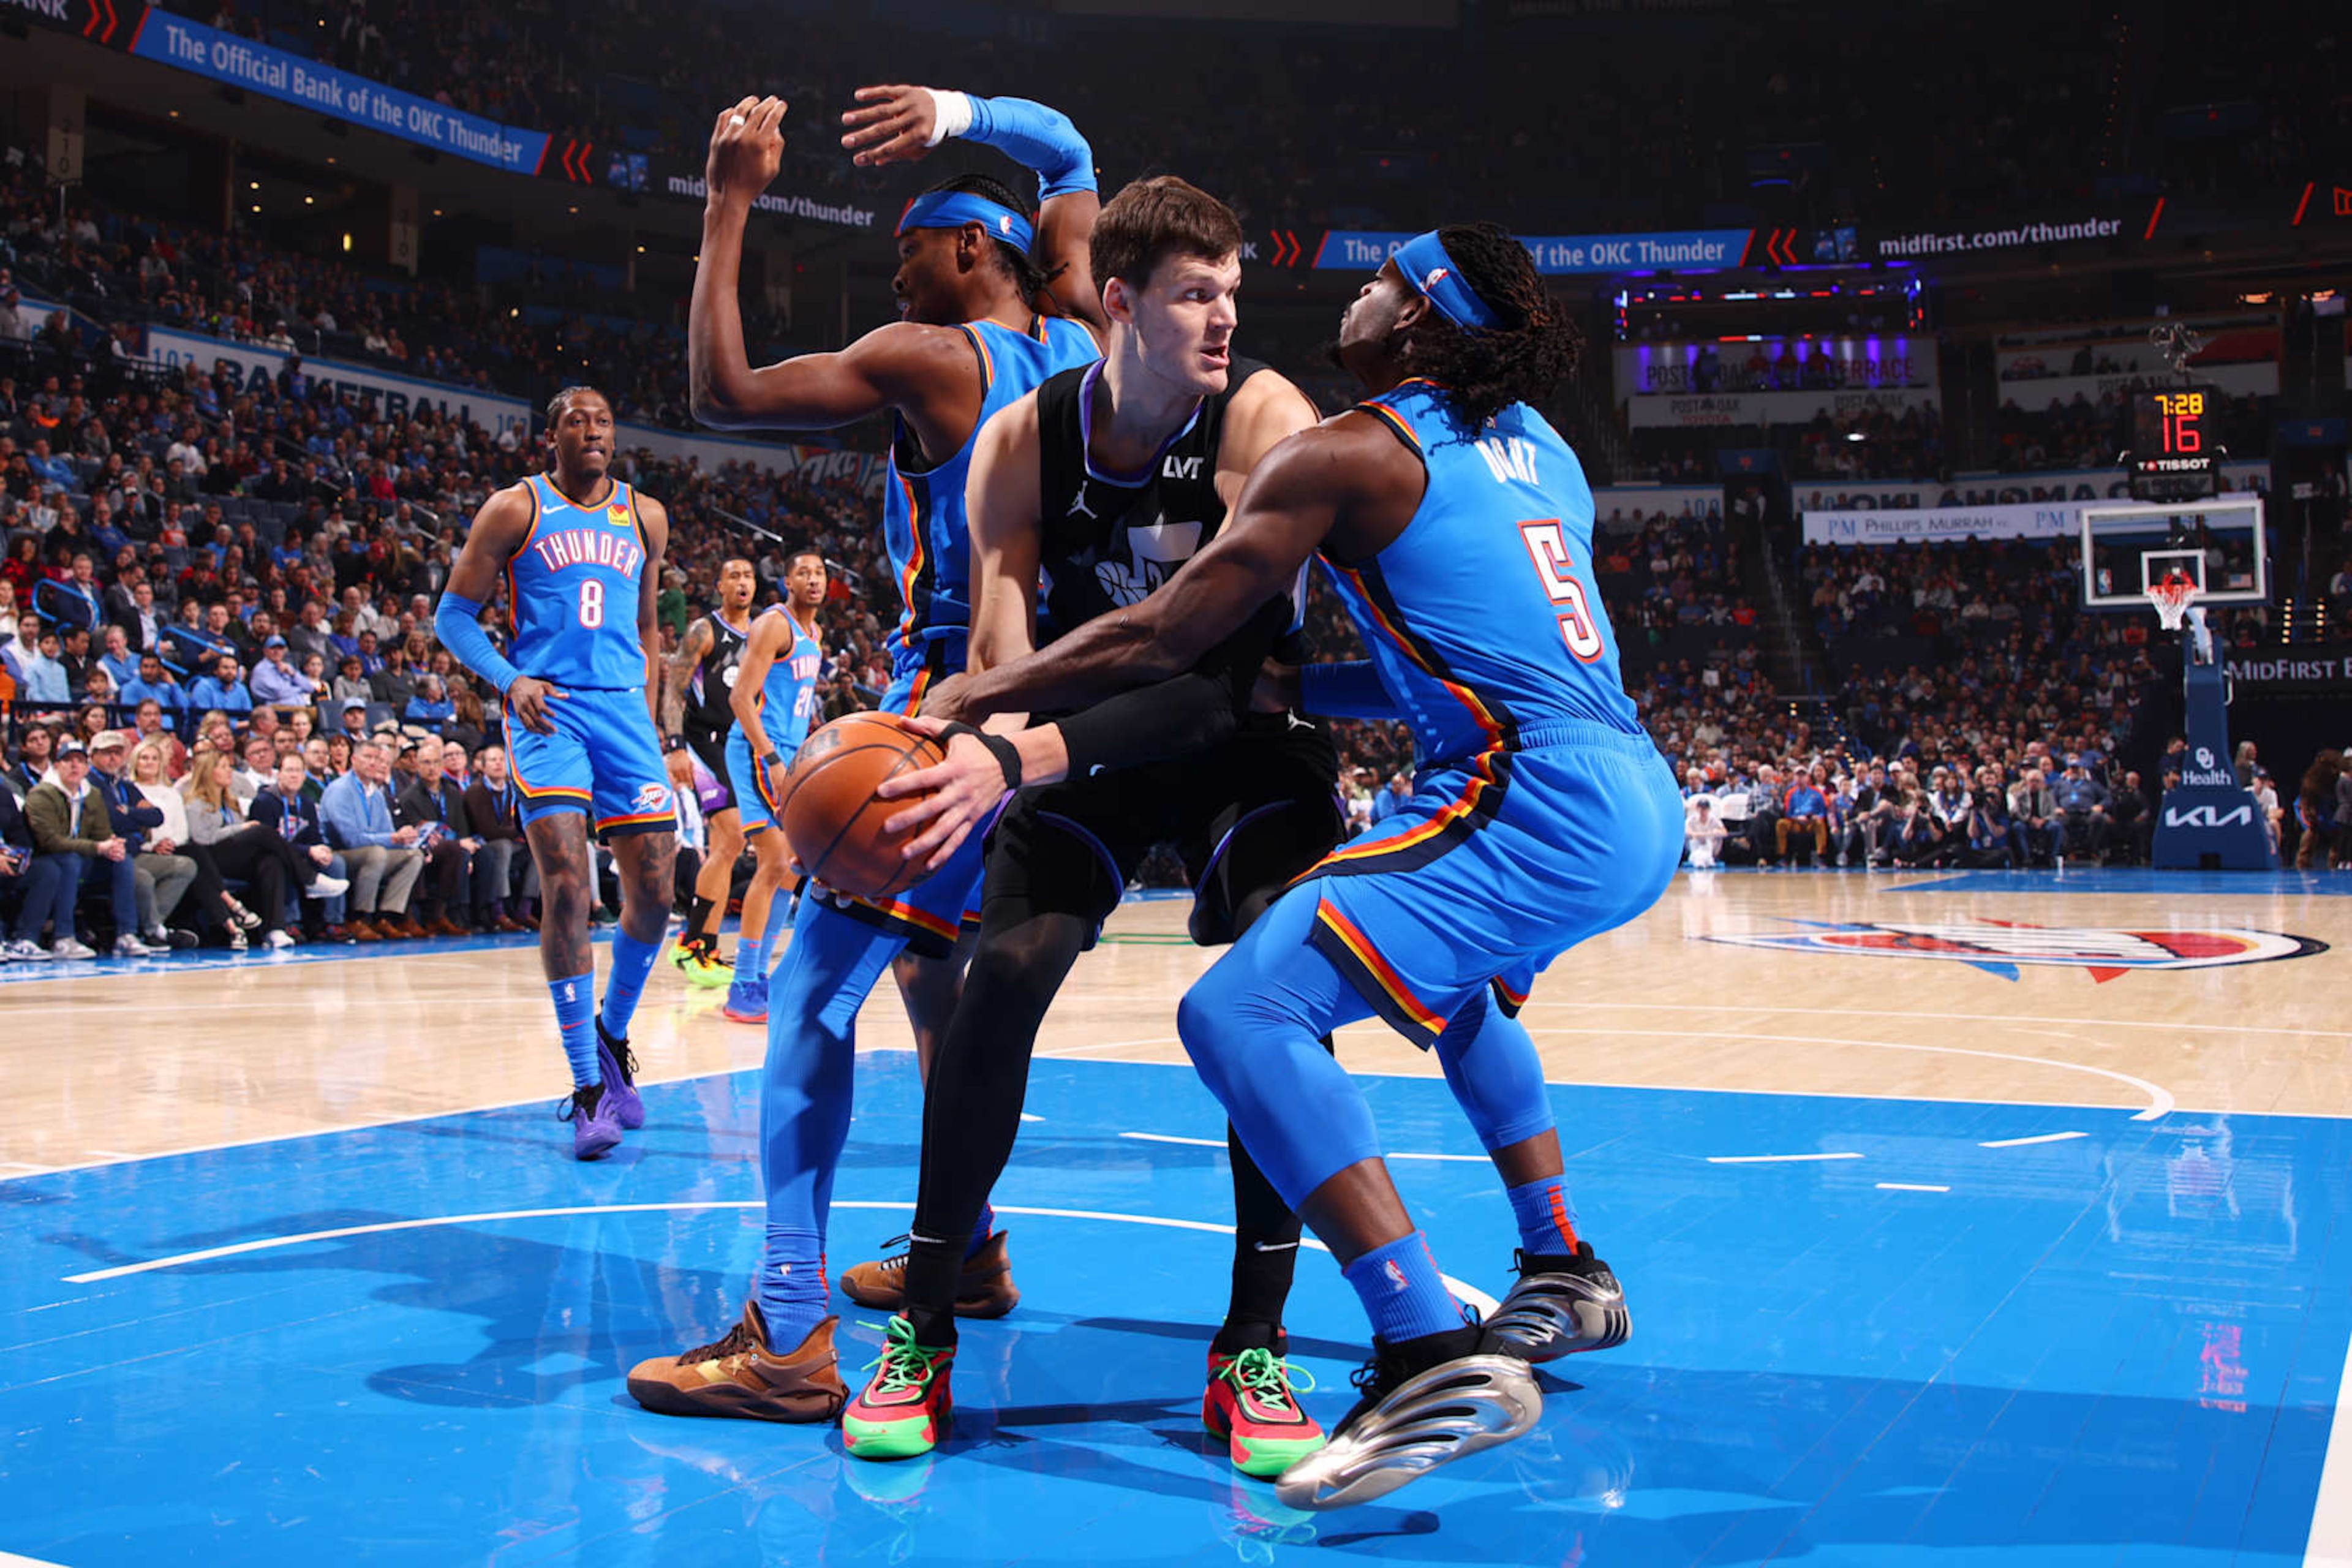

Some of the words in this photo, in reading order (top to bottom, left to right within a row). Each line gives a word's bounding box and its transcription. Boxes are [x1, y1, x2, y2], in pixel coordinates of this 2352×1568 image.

[167, 26, 205, 63] The
[211, 40, 286, 90] Official
[292, 66, 342, 108] Bank
[348, 88, 370, 115] of
[372, 96, 404, 127] the
[407, 105, 443, 141] OKC
[447, 118, 522, 163] Thunder
[1344, 239, 1381, 262] The
[1550, 243, 1585, 267] the
[1591, 241, 1631, 265] OKC
[1637, 238, 1725, 263] Thunder
[1879, 217, 2121, 255] midfirst.com/thunder
[2154, 393, 2203, 415] 7:28
[2163, 415, 2201, 453] 16
[1163, 455, 1204, 480] LVT
[2156, 458, 2211, 472] TISSOT
[1865, 518, 1922, 533] PHILLIPS
[1928, 516, 1993, 532] MURRAH
[533, 529, 639, 579] THUNDER
[579, 578, 605, 630] 8
[1516, 518, 1605, 664] 5
[2182, 769, 2231, 785] Health
